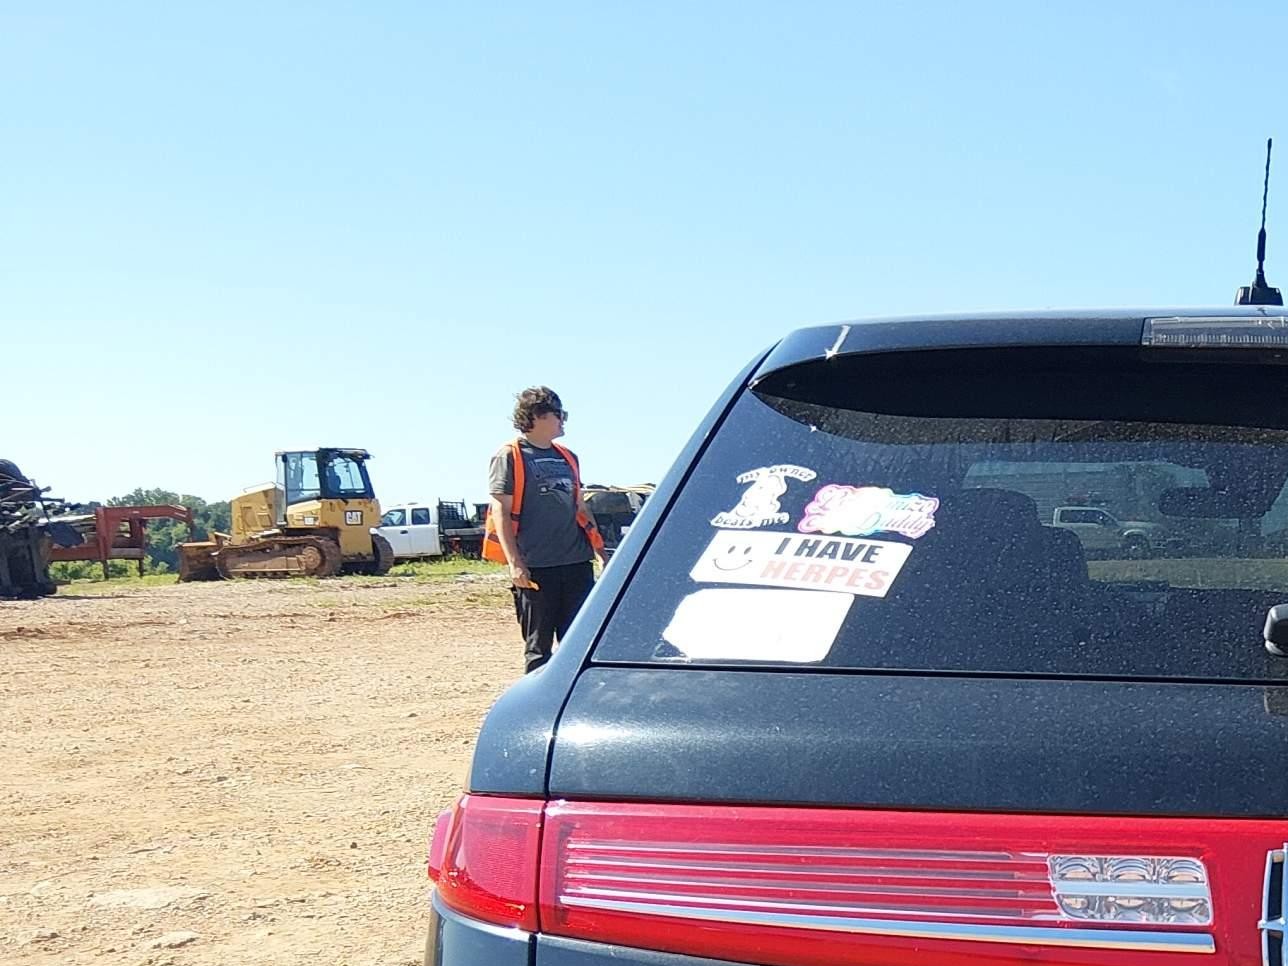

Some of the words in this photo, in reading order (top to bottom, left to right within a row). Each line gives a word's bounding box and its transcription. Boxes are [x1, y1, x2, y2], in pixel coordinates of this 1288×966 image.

[775, 537, 785, 556] I
[794, 539, 884, 564] HAVE
[760, 561, 890, 590] HERPES
